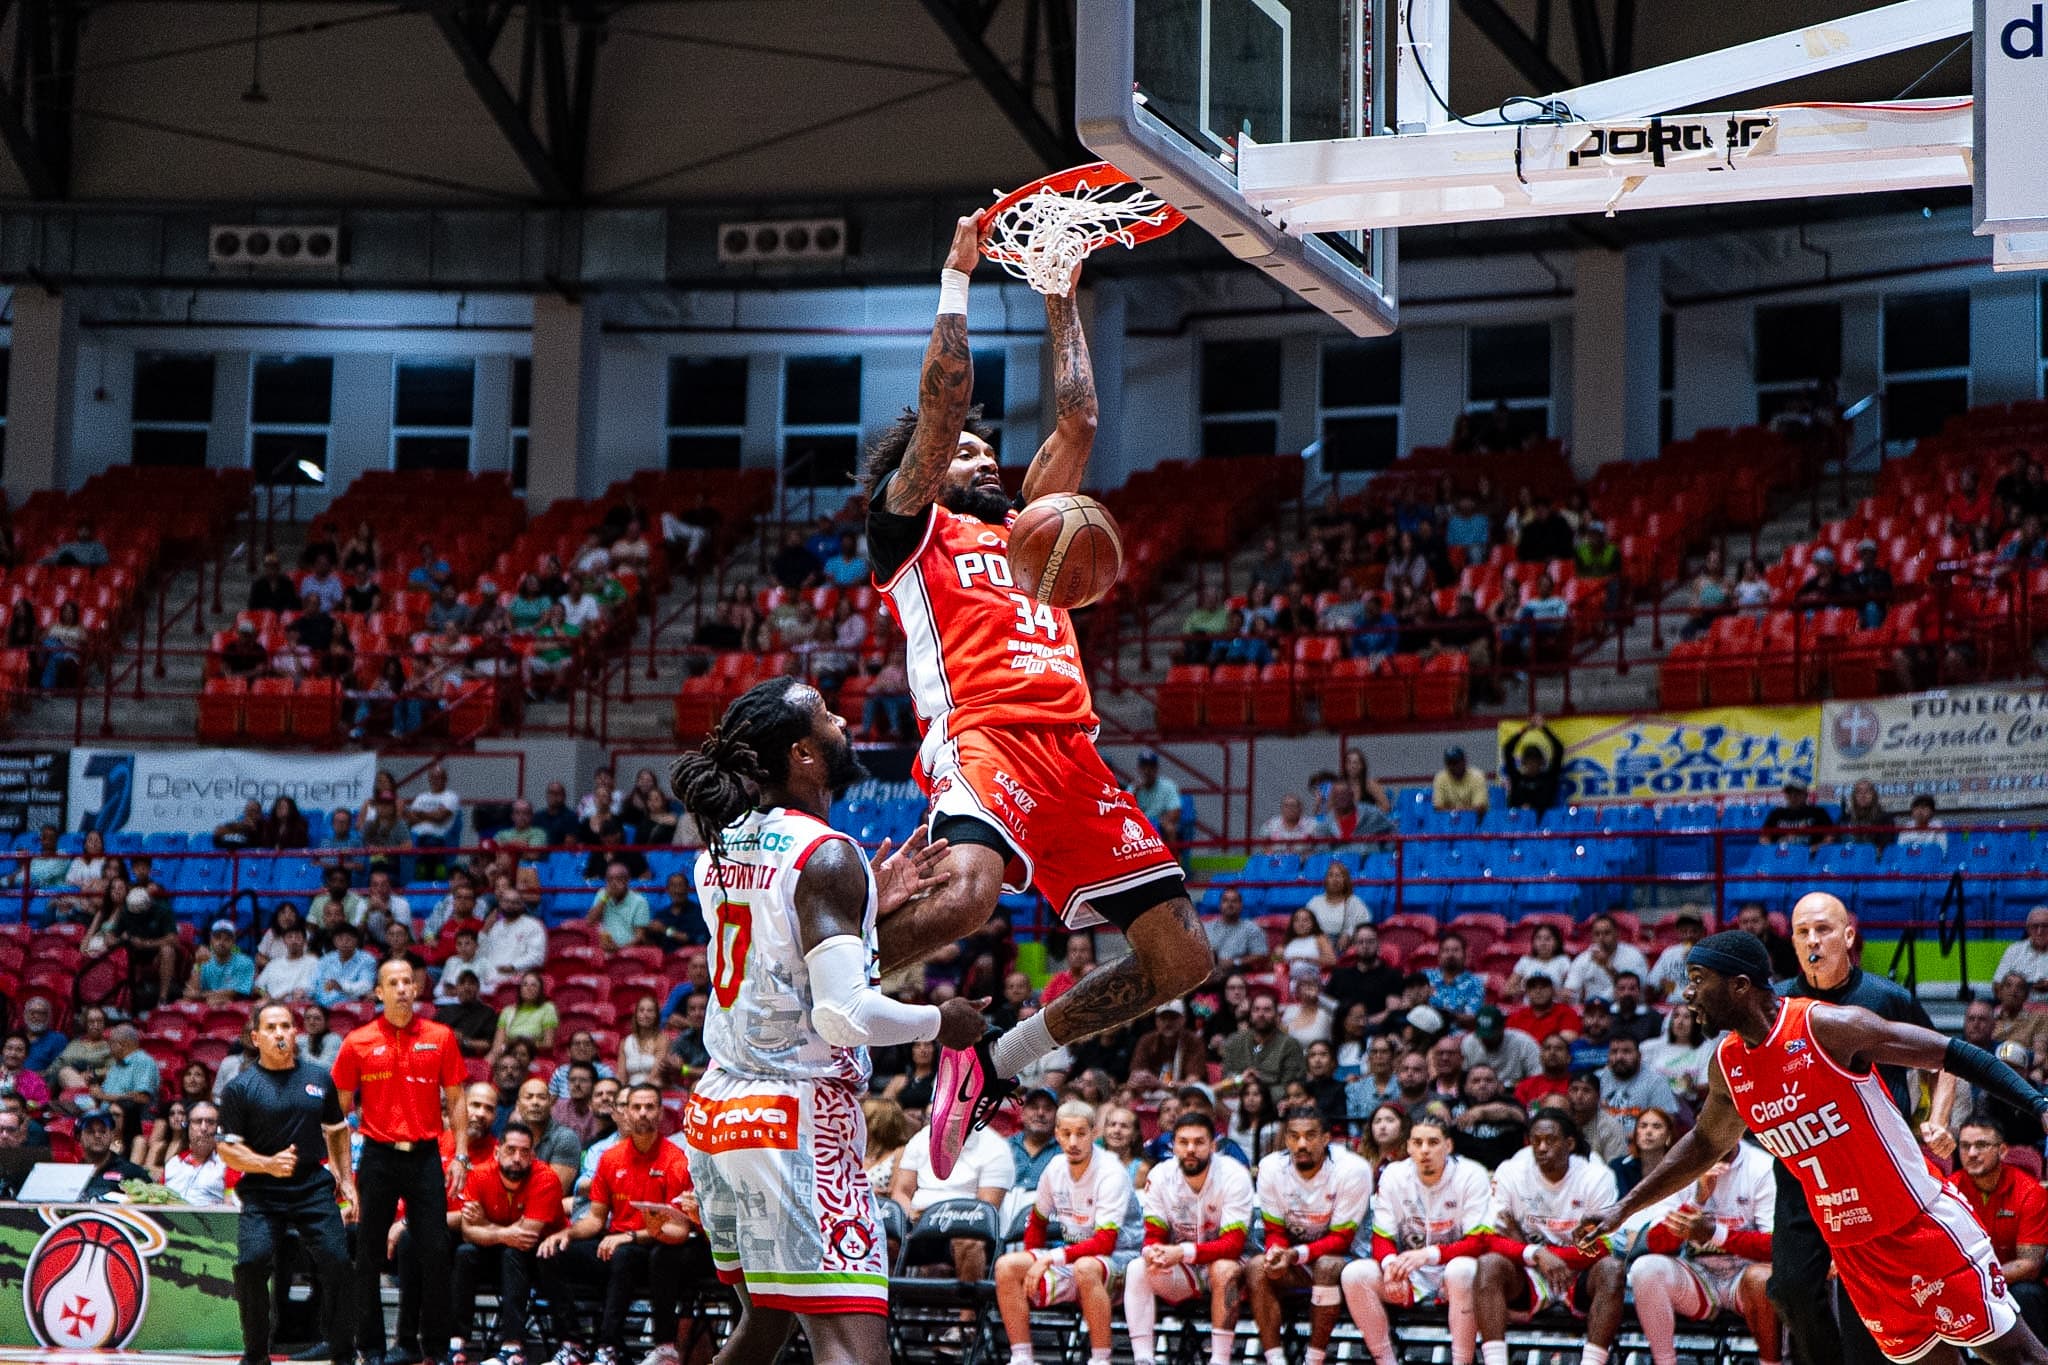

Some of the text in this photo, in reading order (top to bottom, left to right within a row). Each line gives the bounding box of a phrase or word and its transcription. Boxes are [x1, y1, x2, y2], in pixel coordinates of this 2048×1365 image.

[1008, 592, 1058, 641] 34
[1007, 639, 1075, 659] SUNOCO
[1882, 713, 2048, 755] Sagrado Co
[147, 772, 361, 802] Development
[1112, 835, 1165, 857] LOTERÍA
[704, 864, 756, 889] BROWN
[713, 901, 752, 1012] 0
[1750, 1091, 1800, 1124] Claro
[1754, 1101, 1851, 1158] PONCE
[1798, 1155, 1829, 1190] 7
